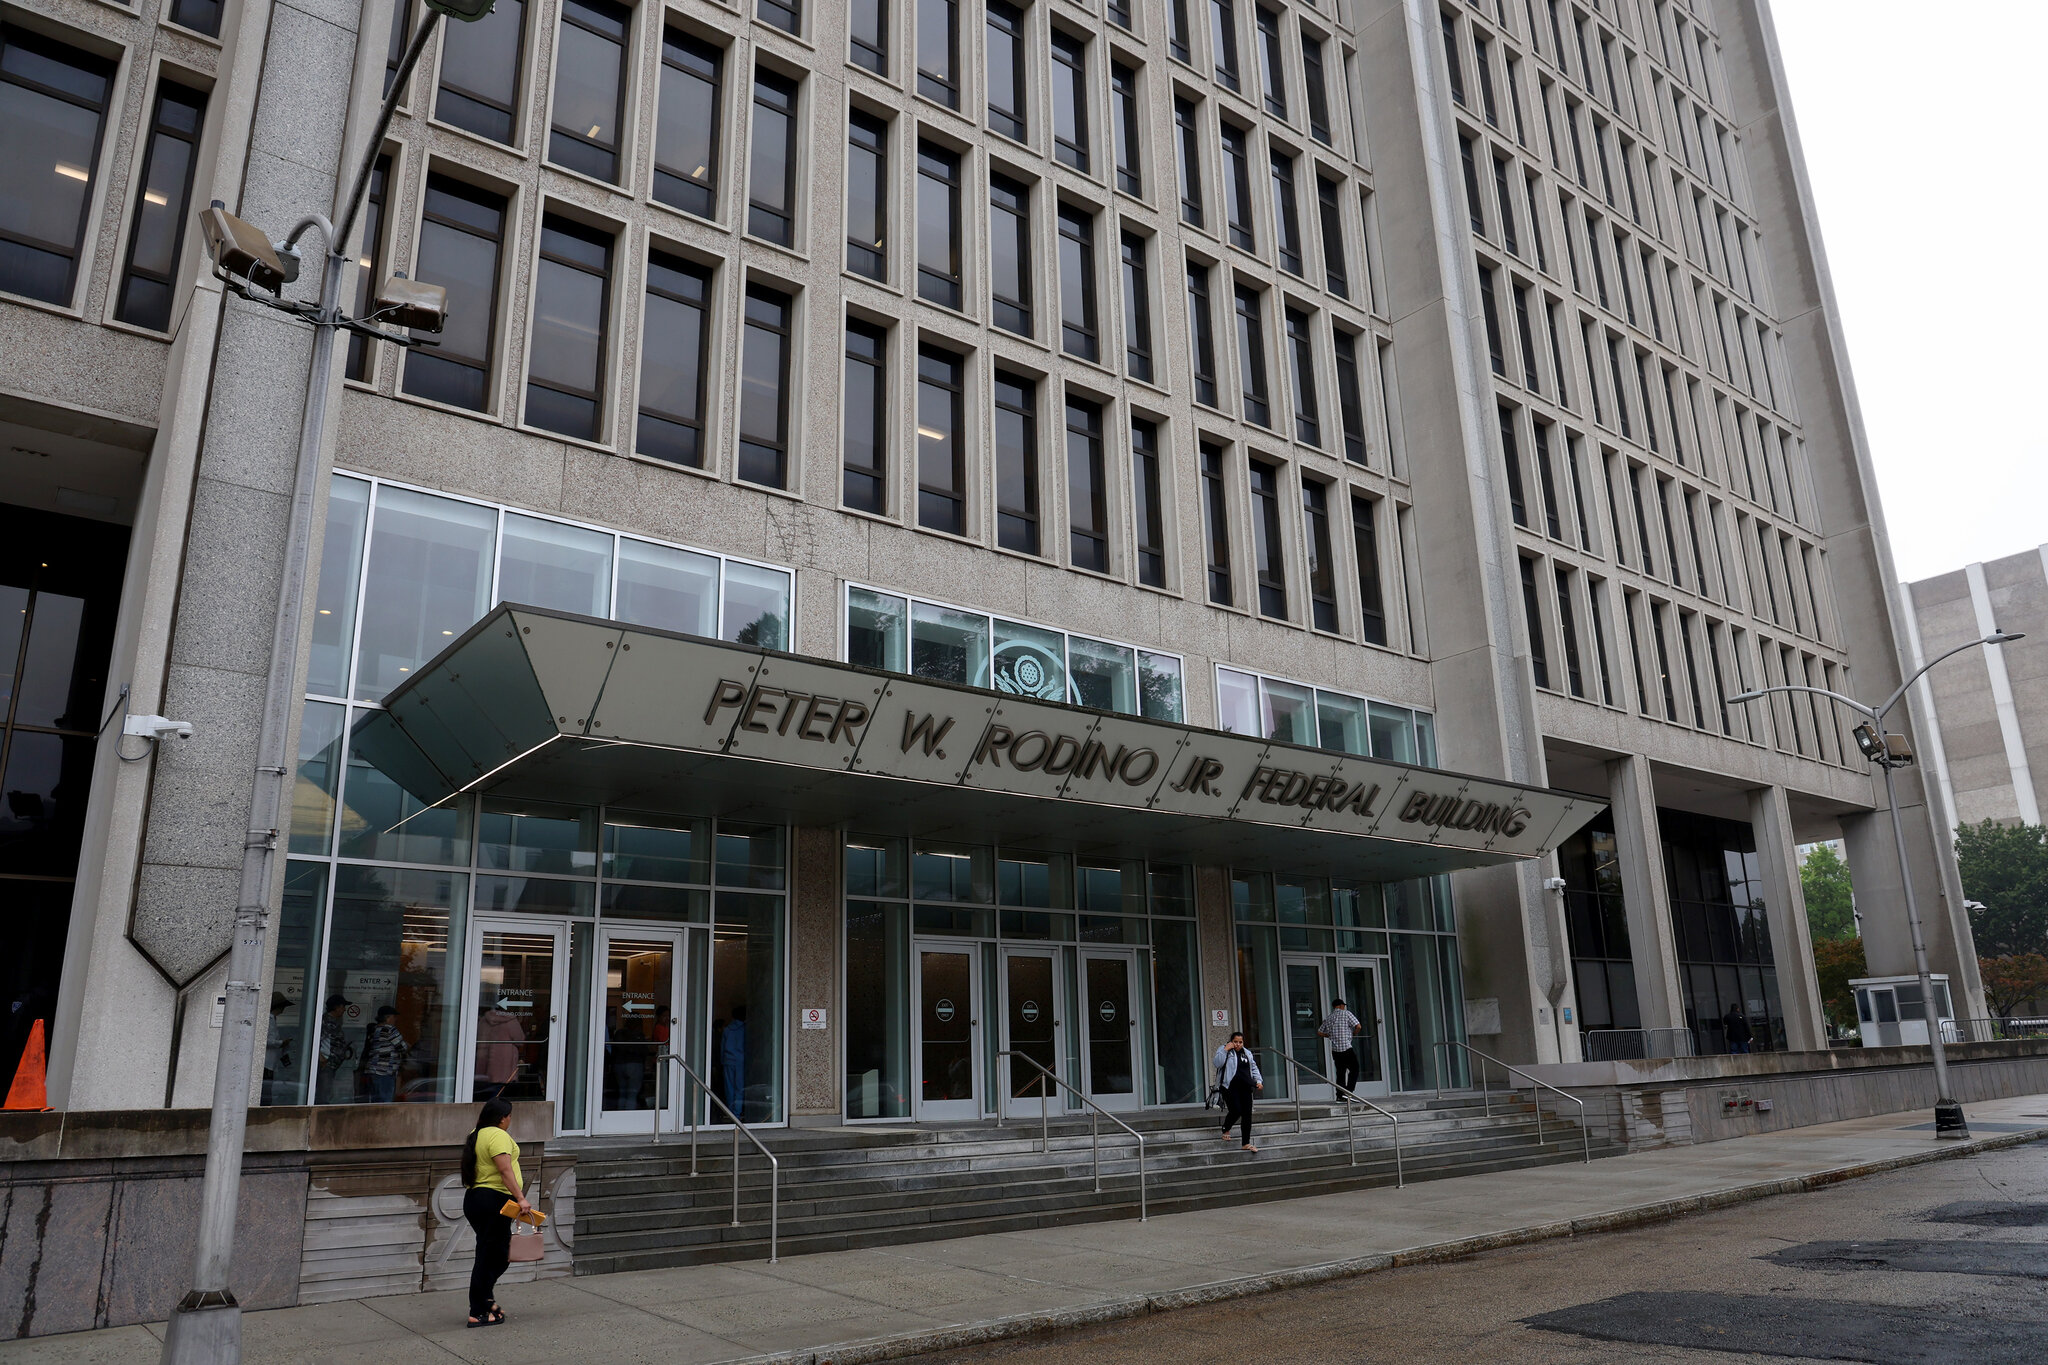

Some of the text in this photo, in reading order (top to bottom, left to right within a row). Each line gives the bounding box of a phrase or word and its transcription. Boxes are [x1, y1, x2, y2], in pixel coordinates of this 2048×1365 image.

[703, 678, 1532, 840] PETER W. RODINO JR. FEDERAL BUILDING
[497, 988, 533, 997] ENTRANCE
